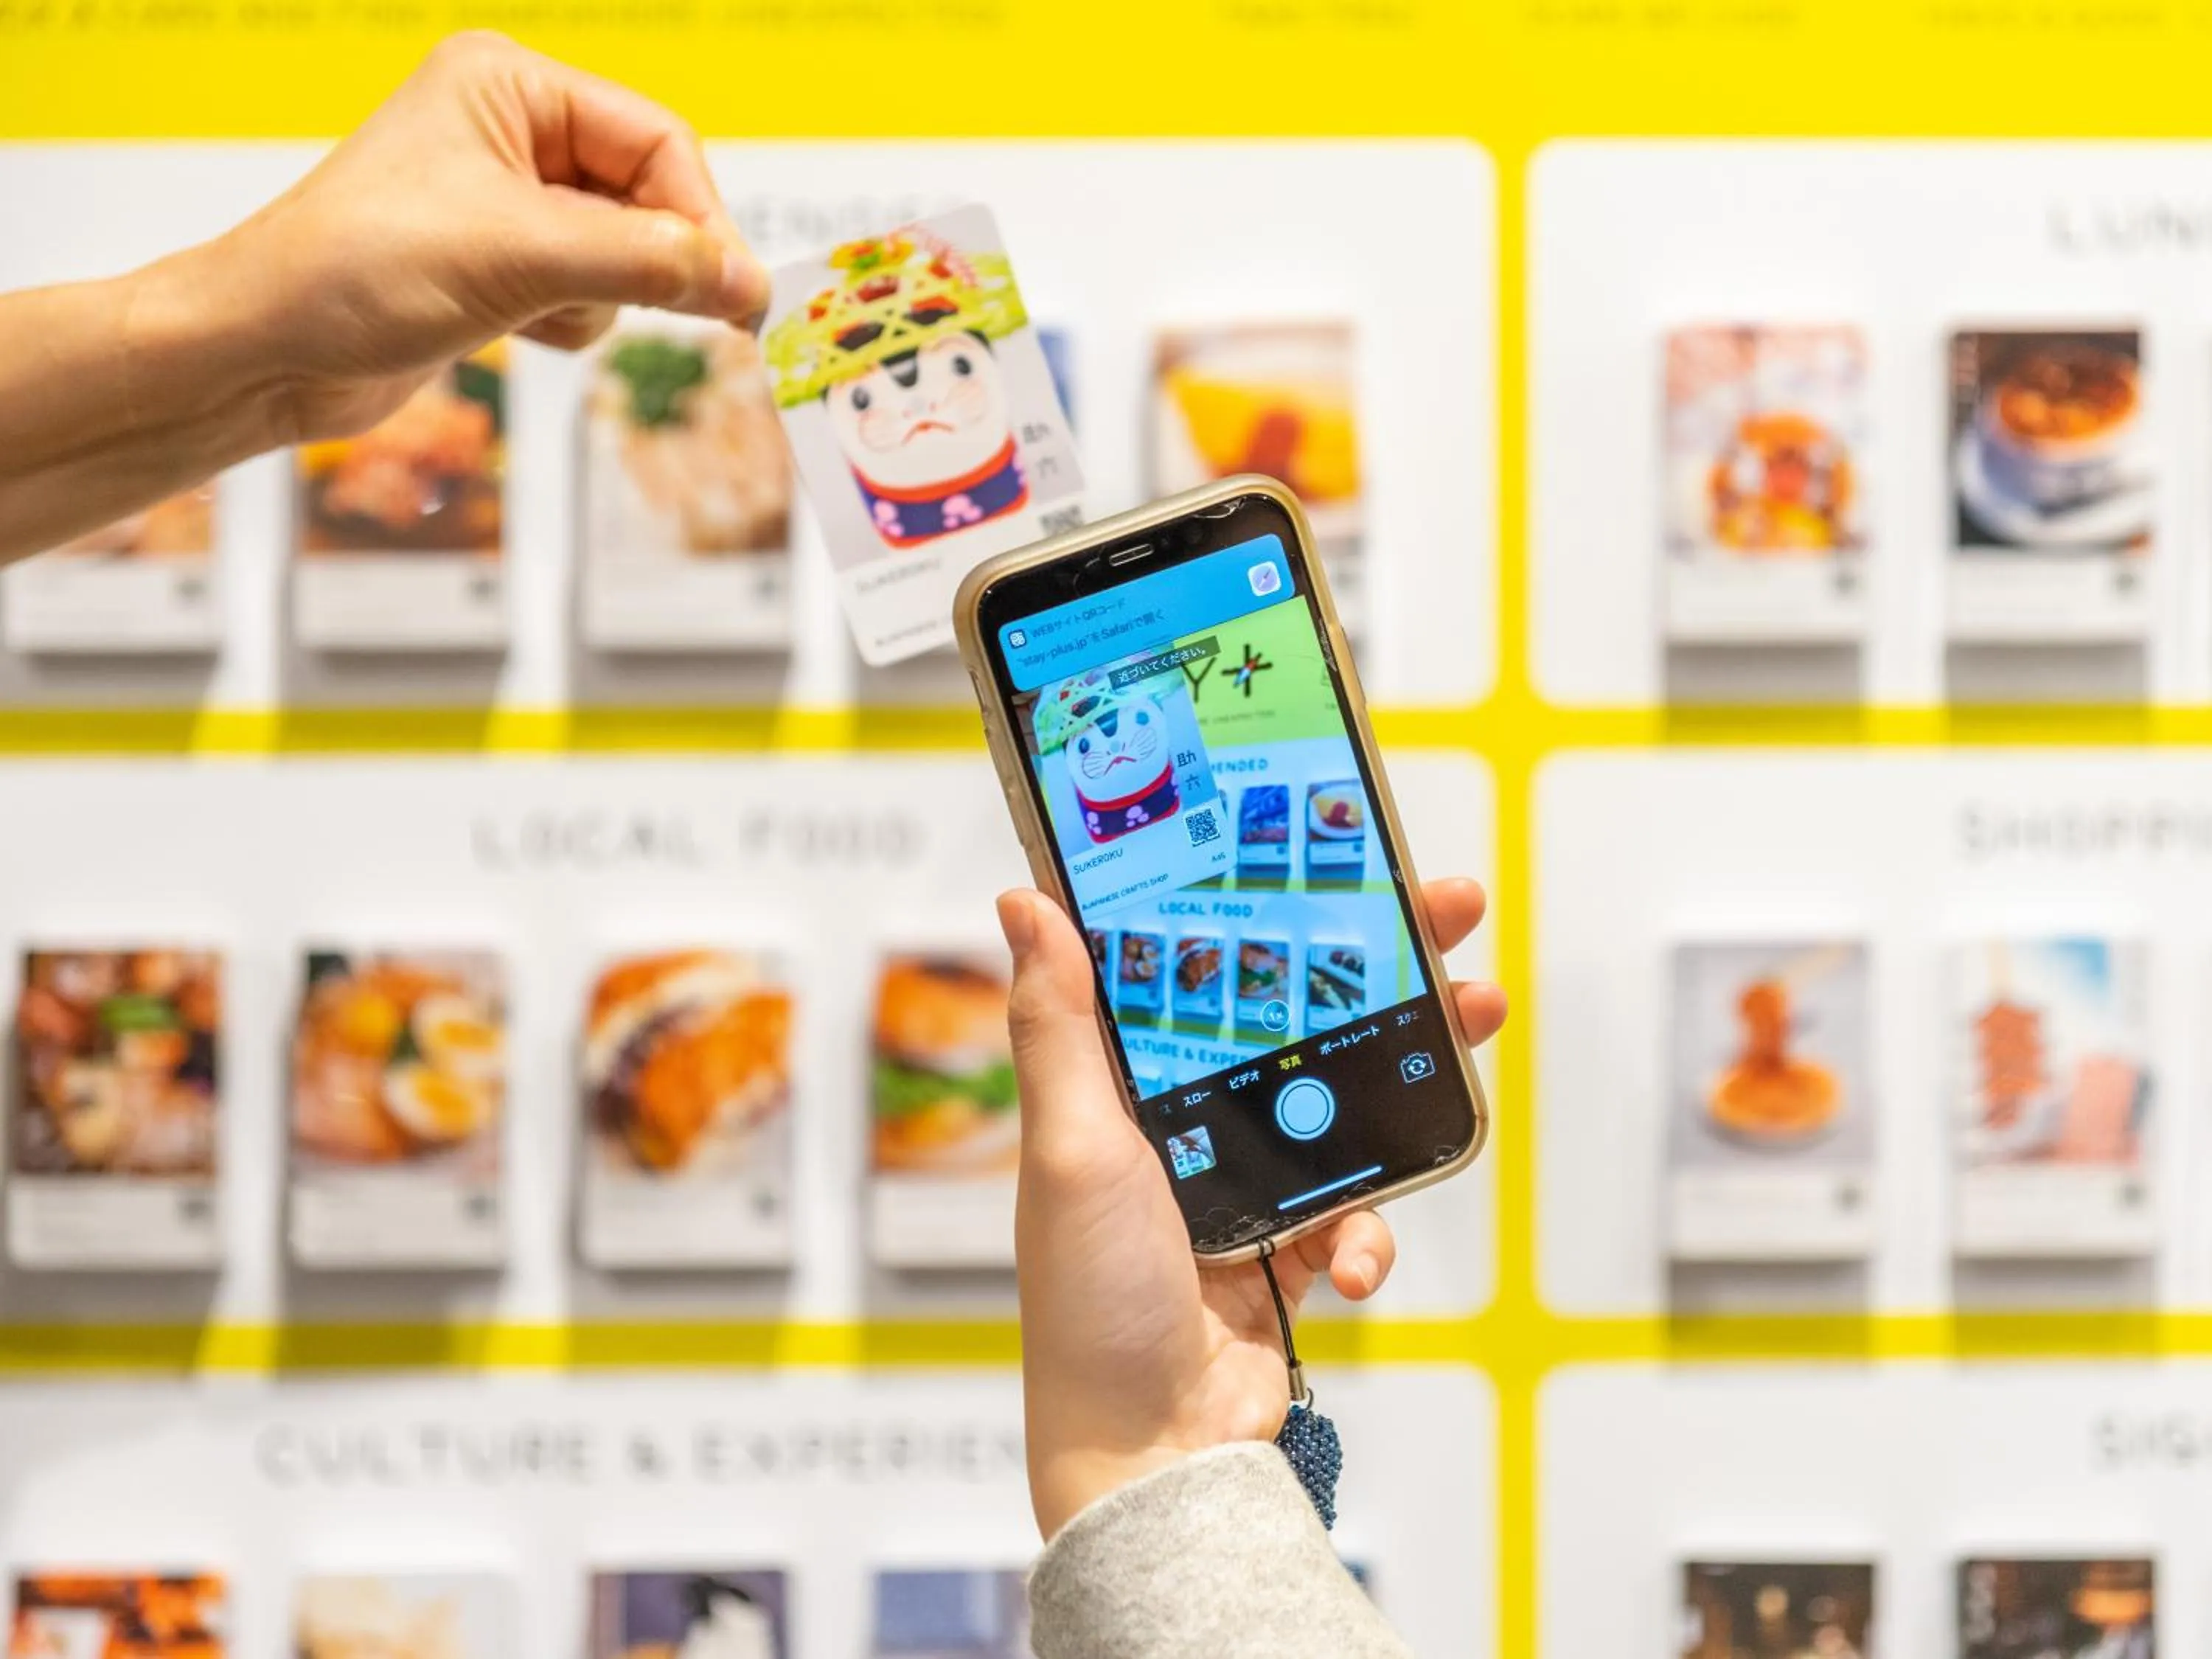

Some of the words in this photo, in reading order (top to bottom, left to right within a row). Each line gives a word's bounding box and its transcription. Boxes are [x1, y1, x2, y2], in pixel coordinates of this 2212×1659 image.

[1073, 848, 1123, 874] SUKEROKU
[1150, 873, 1169, 886] SHOP
[1158, 901, 1206, 917] LOCAL
[1213, 902, 1253, 917] FOOD
[1229, 1070, 1260, 1090] ビデオ
